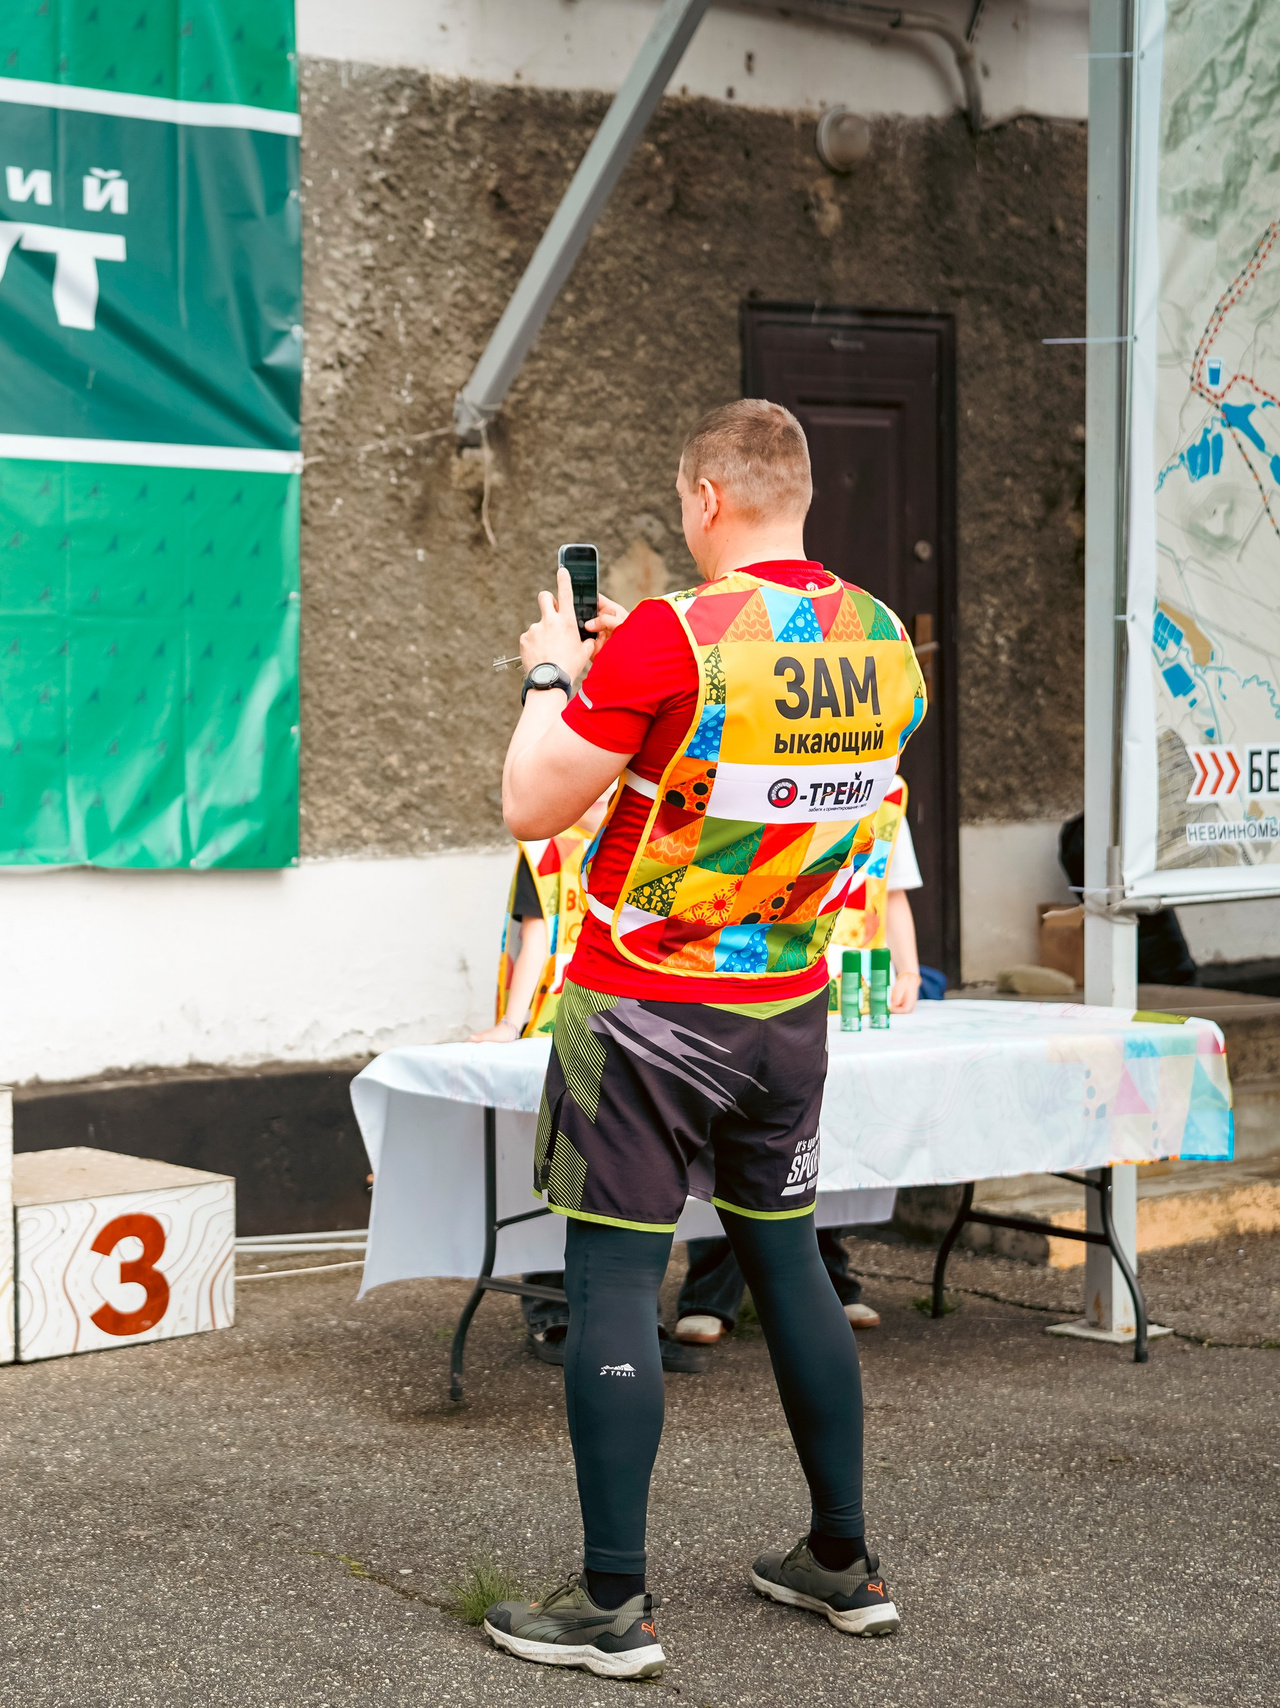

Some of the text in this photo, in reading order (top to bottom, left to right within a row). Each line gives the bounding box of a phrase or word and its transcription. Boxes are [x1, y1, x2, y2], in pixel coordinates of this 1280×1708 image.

[773, 655, 881, 720] ЗАМ
[773, 722, 884, 756] ыкающий
[1249, 748, 1280, 794] БЕ
[89, 1211, 170, 1336] 3
